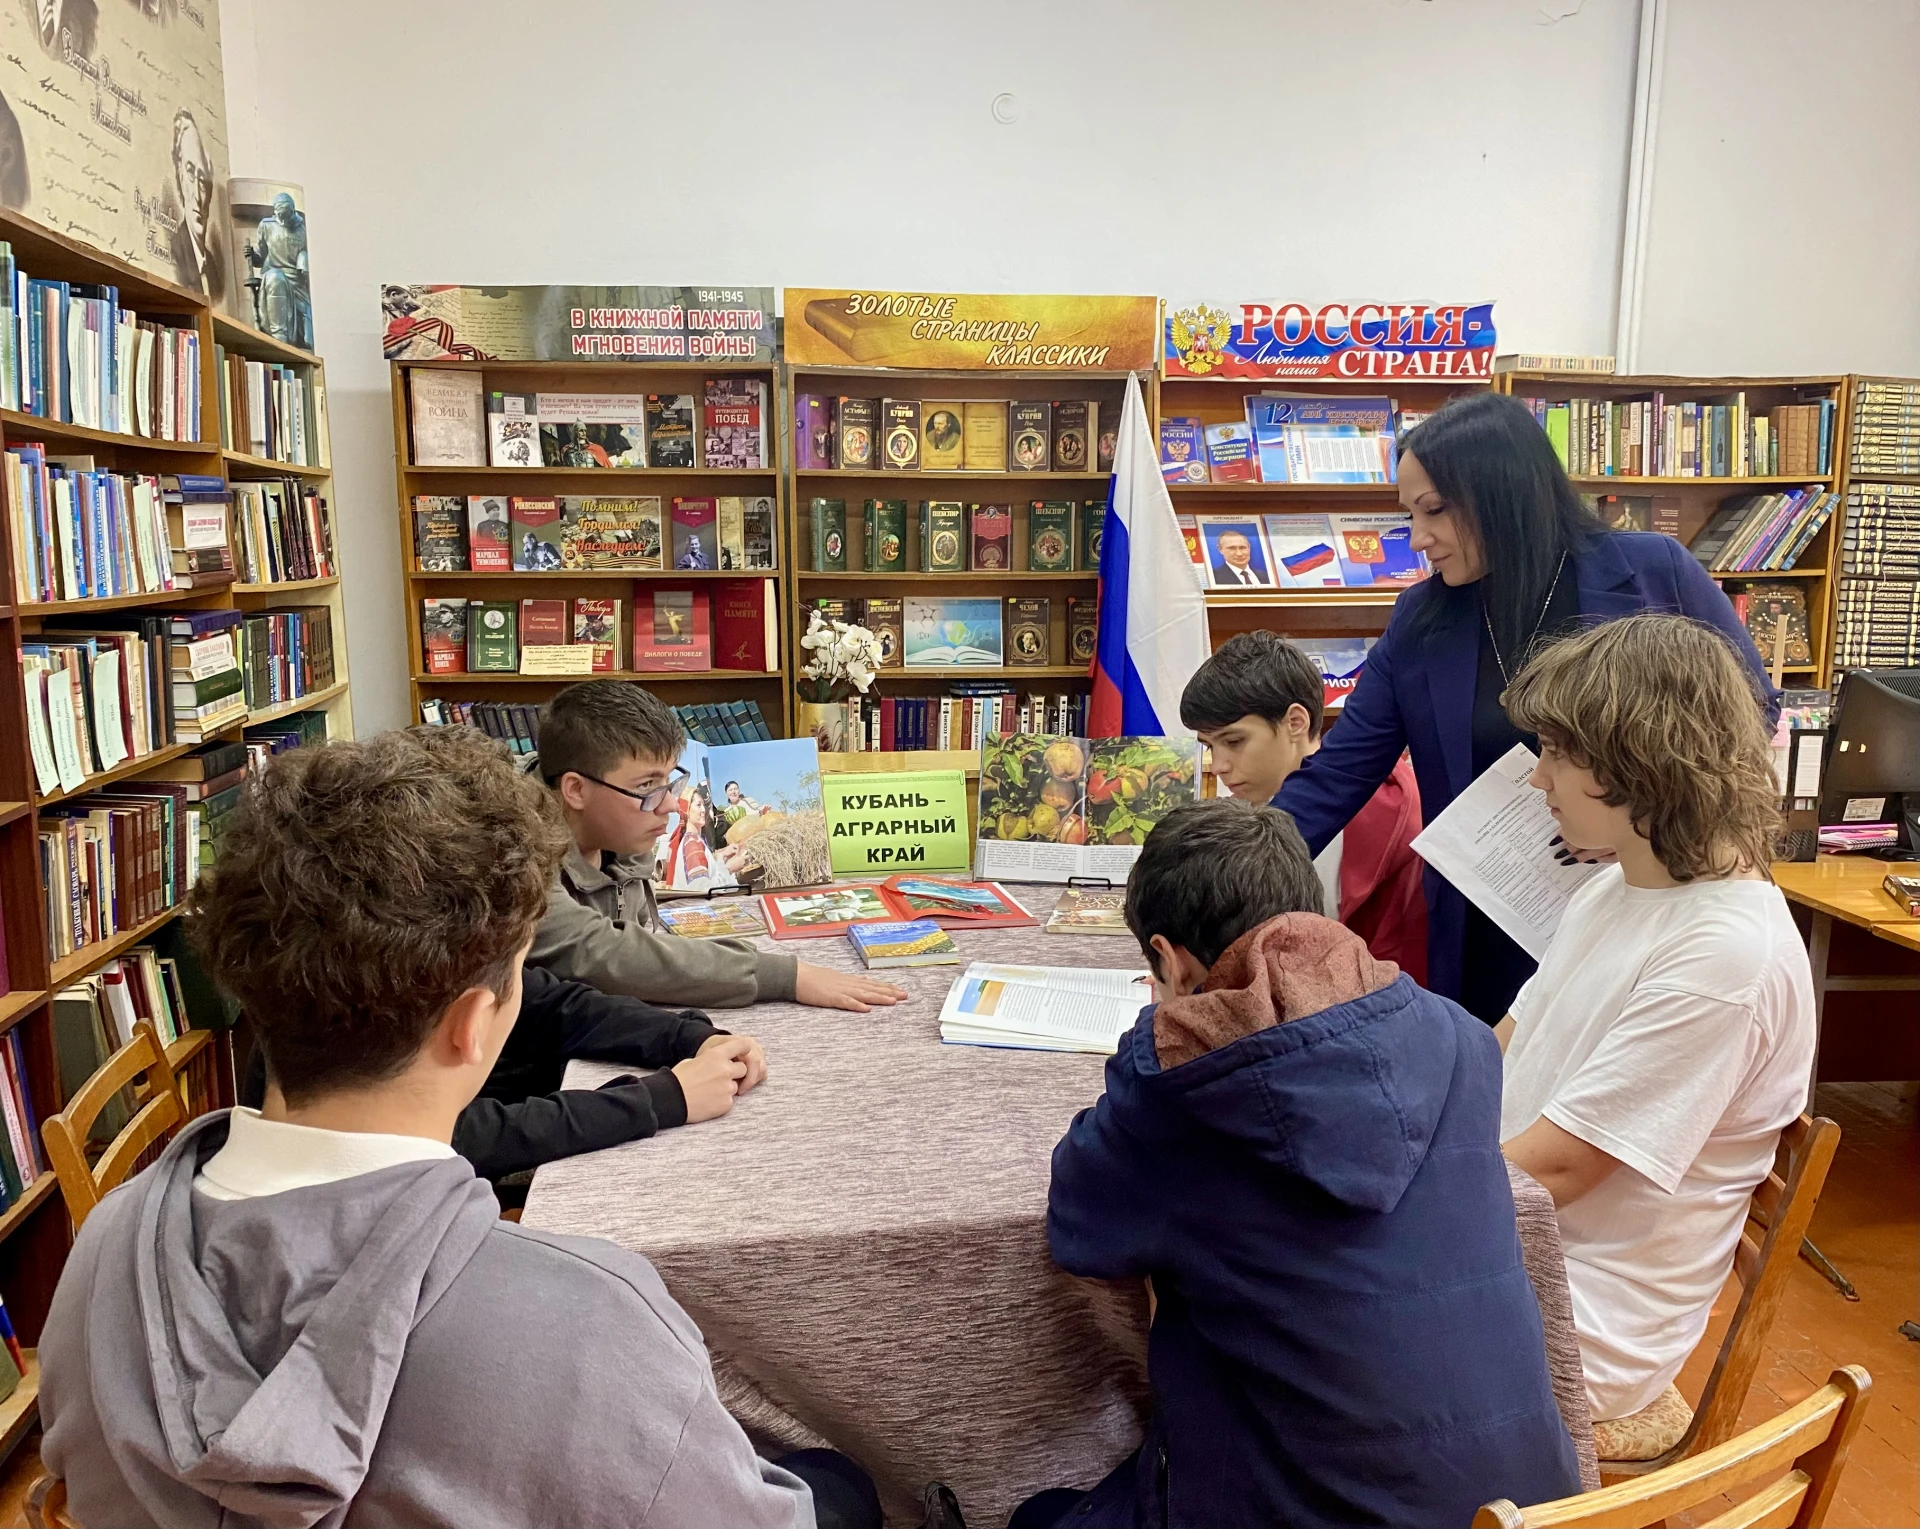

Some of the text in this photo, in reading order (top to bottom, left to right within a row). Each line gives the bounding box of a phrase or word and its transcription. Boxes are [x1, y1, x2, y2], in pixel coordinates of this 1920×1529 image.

[698, 290, 743, 303] 1941-1945
[845, 293, 957, 319] ЗОЛОТЫЕ
[571, 305, 762, 330] В КНИЖНОЙ ПАМЯТИ
[911, 320, 1040, 346] СТРАНИЦЫ
[572, 331, 756, 356] МГНОВЕНИЯ ВОЙНЫ
[985, 345, 1109, 367] КЛАССИКИ
[1234, 338, 1489, 377] Любимая СТРАНА!
[1275, 366, 1320, 376] наша
[428, 405, 468, 418] ВОЙНА
[715, 414, 750, 425] ПОБЕД
[1264, 402, 1293, 425] 12
[1295, 445, 1303, 464] ГИМН
[514, 501, 555, 510] РОКОССОВСКИЙ
[581, 500, 638, 513] Помним!
[578, 519, 640, 533] Гордимся!
[576, 539, 647, 554] Наследуем!
[724, 610, 757, 618] ПАМЯТИ
[841, 793, 929, 811] КУБАНЬ
[832, 814, 956, 838] АГРАРНЫЙ
[866, 842, 926, 865] КРАЙ
